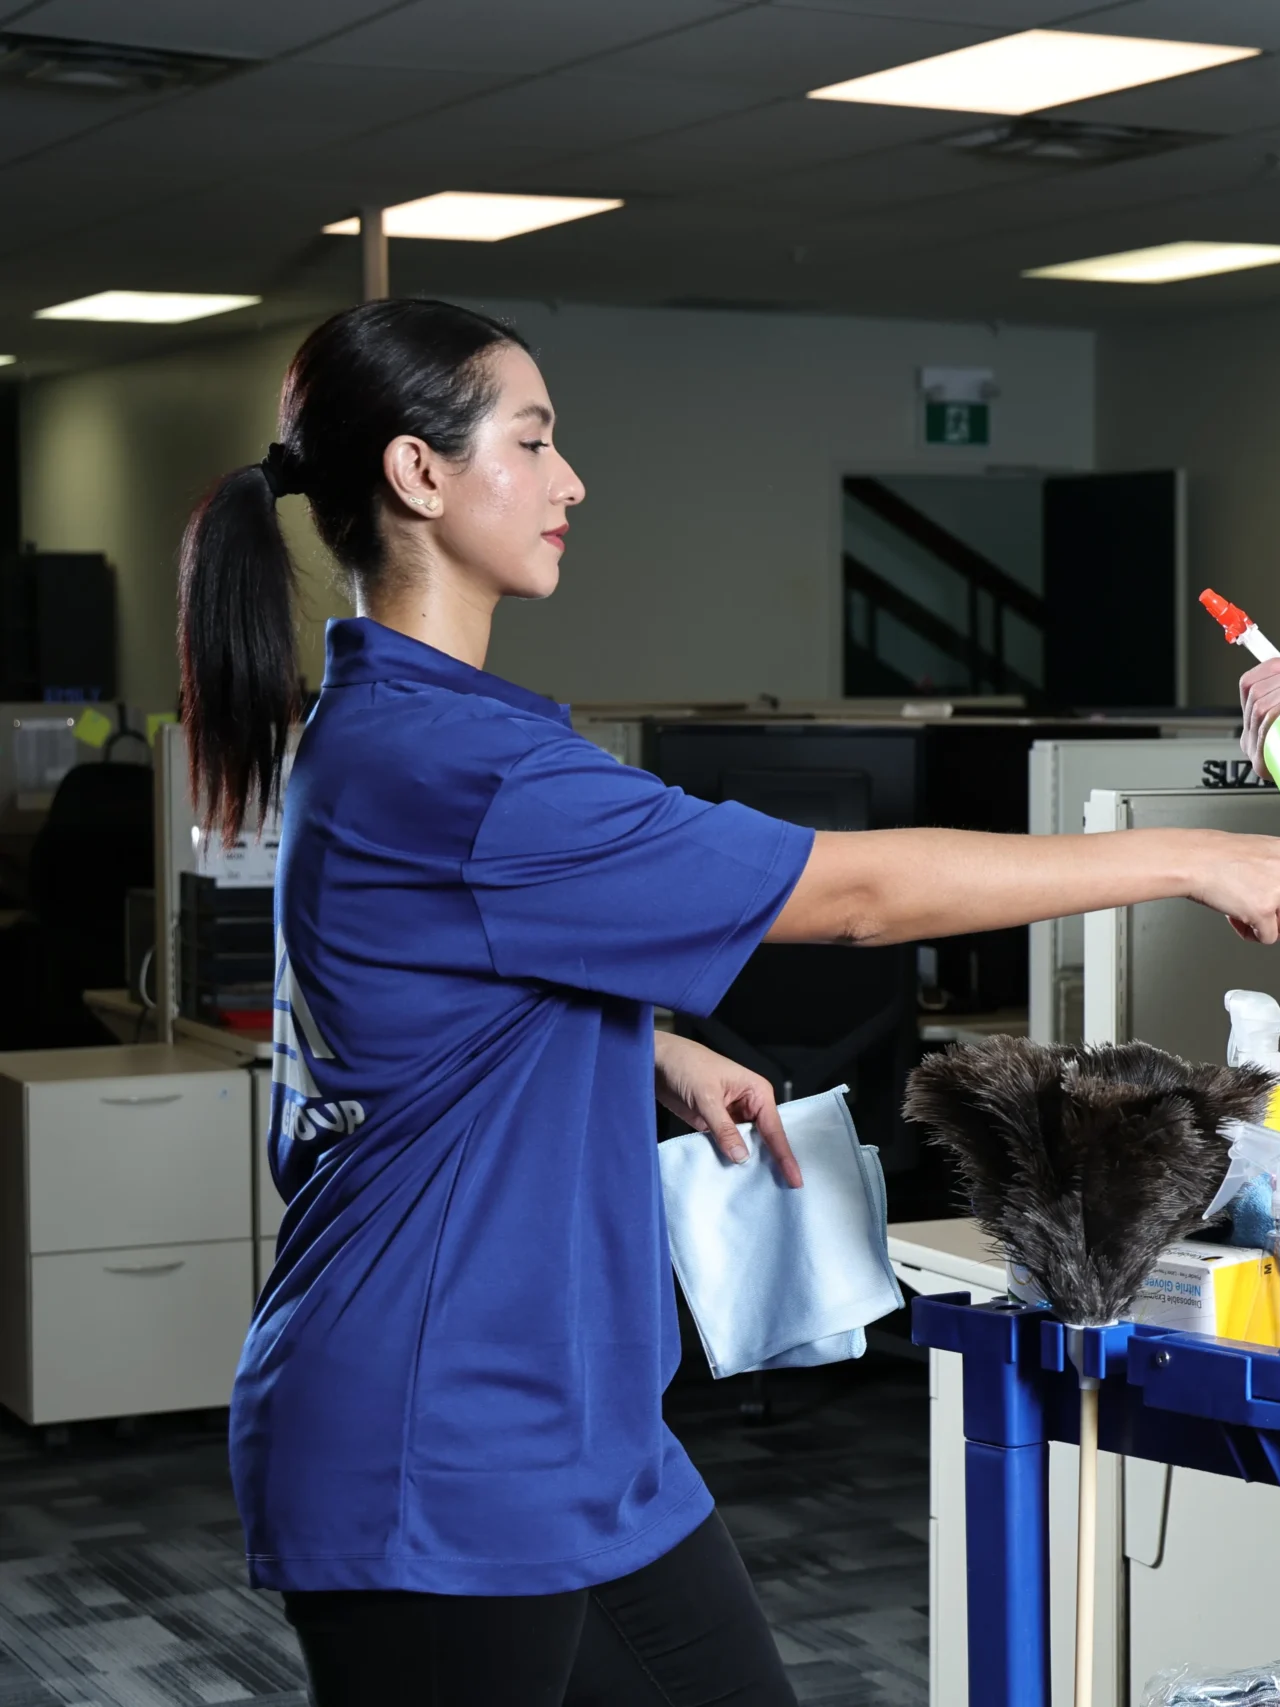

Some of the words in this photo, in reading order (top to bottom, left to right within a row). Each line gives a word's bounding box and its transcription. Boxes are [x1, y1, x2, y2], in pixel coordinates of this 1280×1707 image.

[282, 1099, 365, 1141] GROUP
[1264, 1264, 1272, 1275] M
[1145, 1278, 1173, 1293] Gloves
[1176, 1282, 1201, 1297] Nitrile
[1167, 1295, 1202, 1309] Disposable
